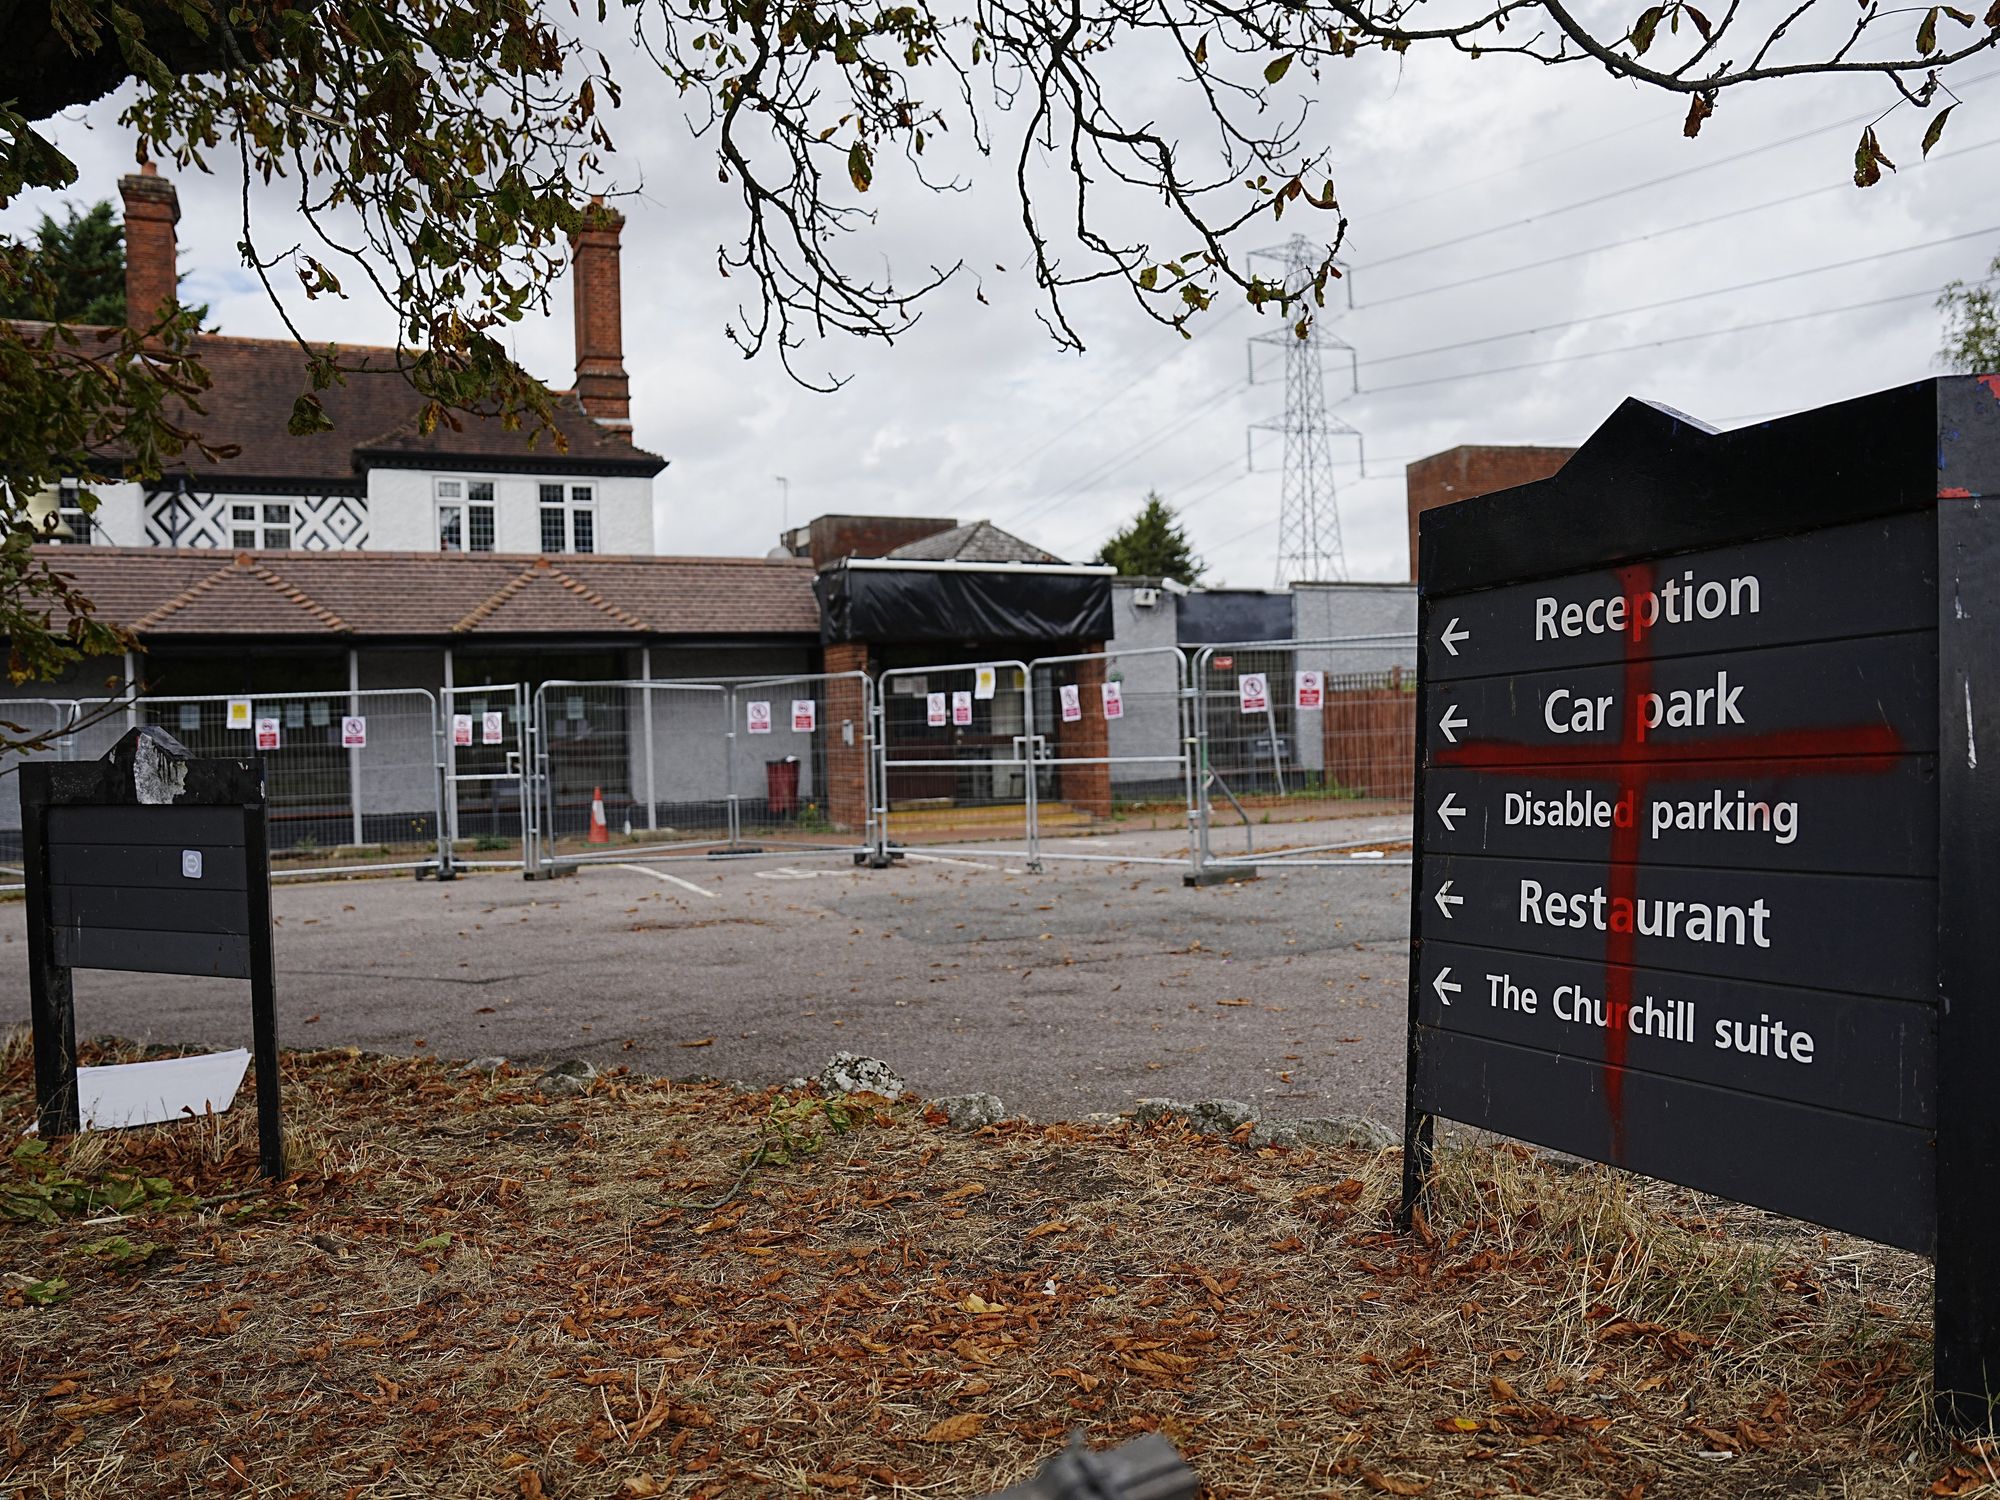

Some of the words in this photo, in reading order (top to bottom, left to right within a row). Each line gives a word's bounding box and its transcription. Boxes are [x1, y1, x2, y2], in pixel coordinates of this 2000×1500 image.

[1535, 570, 1760, 641] Reception
[1544, 688, 1613, 734] Car
[1636, 671, 1745, 742] park
[1504, 789, 1635, 828] Disabled
[1652, 789, 1799, 845] parking
[1520, 879, 1771, 948] Restaurant
[1486, 973, 1538, 1015] The
[1552, 985, 1695, 1043] Churchill
[1714, 1013, 1816, 1064] suite
